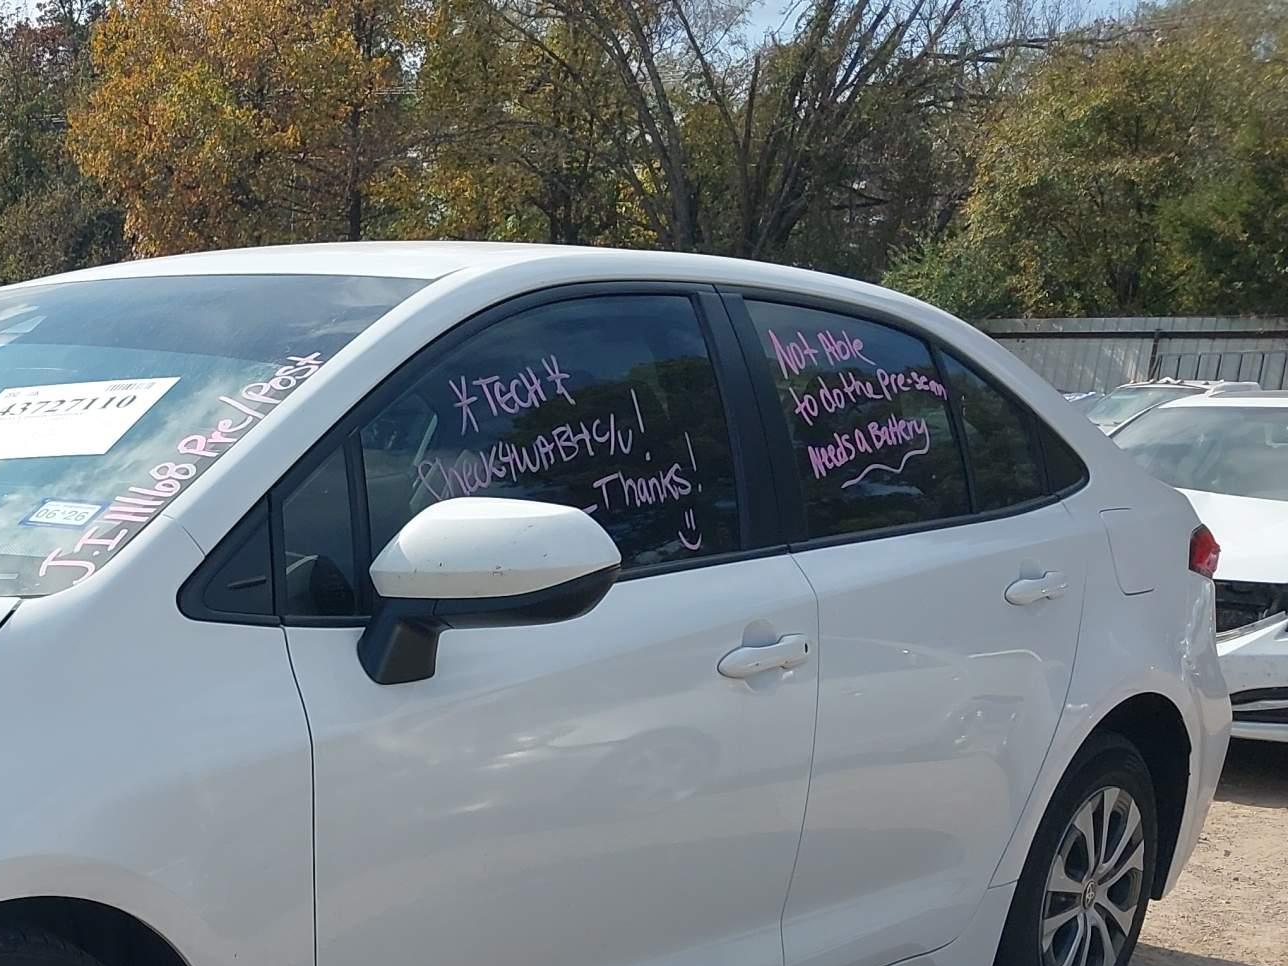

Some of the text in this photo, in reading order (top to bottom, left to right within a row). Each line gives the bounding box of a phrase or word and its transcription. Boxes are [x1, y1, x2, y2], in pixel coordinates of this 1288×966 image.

[768, 329, 876, 380] Not Able
[177, 351, 329, 458] Pre/Post
[789, 386, 819, 426] to
[818, 376, 845, 413] do
[839, 371, 884, 402] the
[867, 413, 930, 454] Battery
[592, 431, 703, 509] Thanks!
